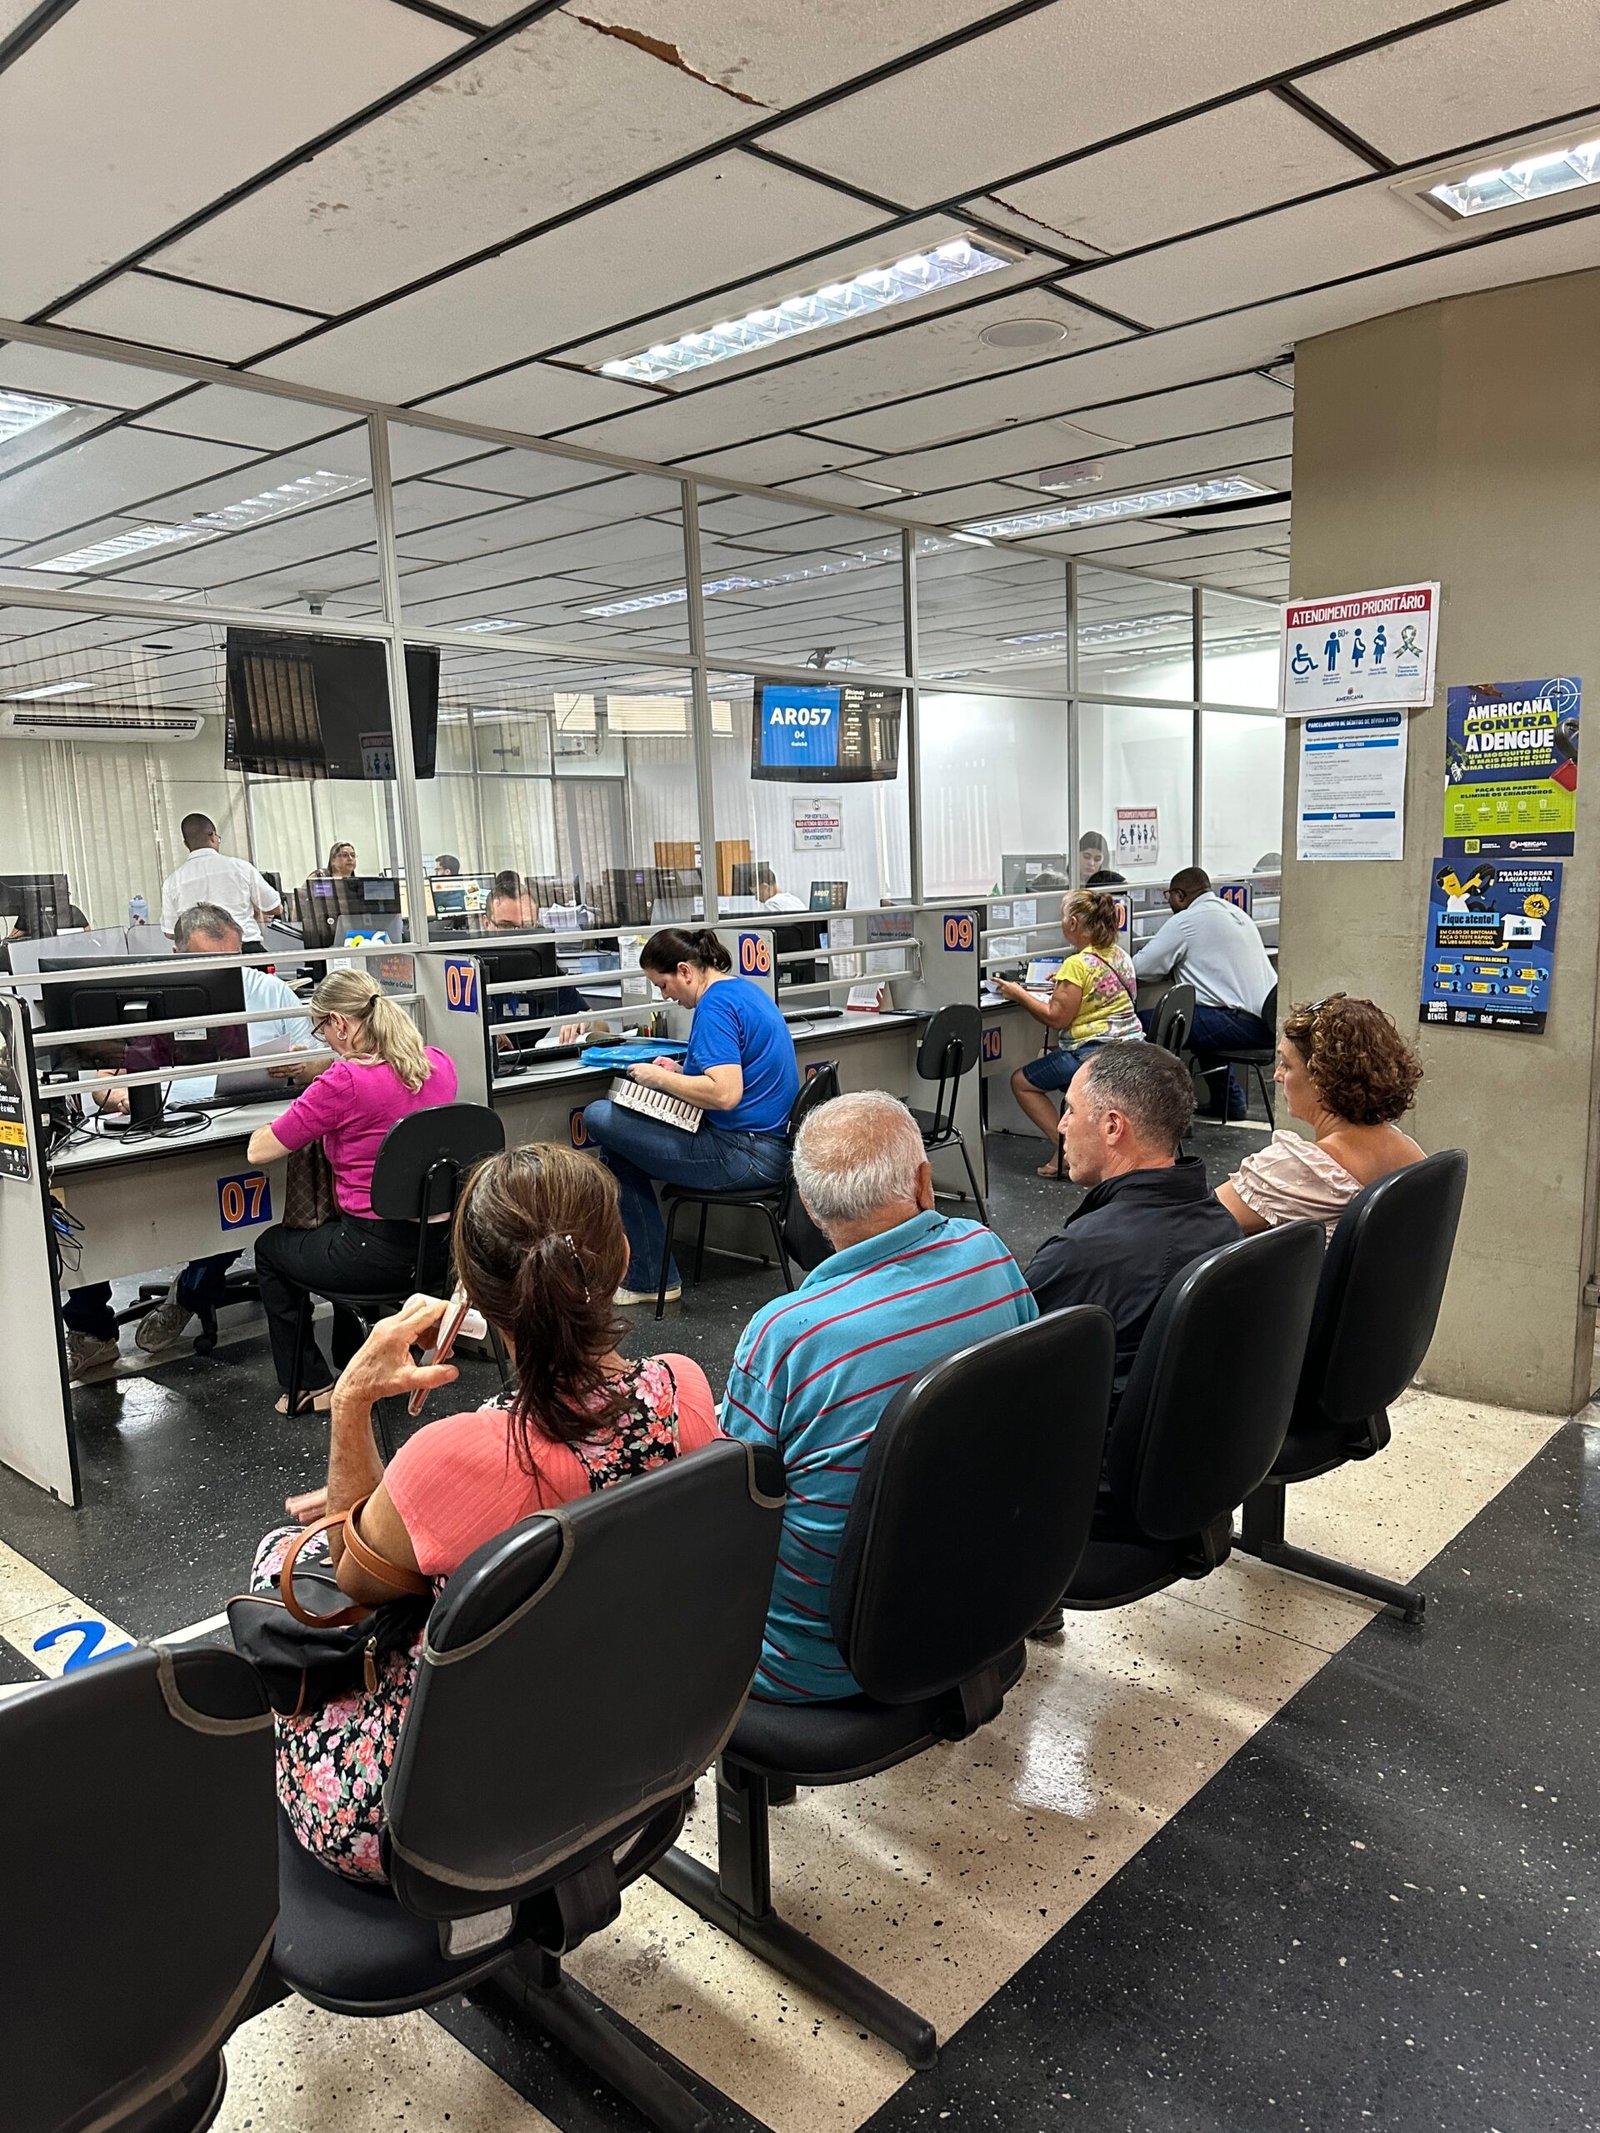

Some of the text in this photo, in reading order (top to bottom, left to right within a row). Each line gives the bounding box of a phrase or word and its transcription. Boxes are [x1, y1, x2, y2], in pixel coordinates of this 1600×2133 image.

[1292, 592, 1426, 626] ATENDIMENTO PRIORITÁRIO
[1336, 694, 1364, 702] AMERICANA
[770, 707, 832, 726] AR057
[1467, 699, 1552, 720] AMERICANA
[1467, 715, 1552, 732] CONTRA
[794, 730, 805, 739] 04
[1466, 729, 1554, 752] A DENGUE
[1484, 750, 1531, 758] MOSQUITO
[1520, 758, 1558, 766] INTEIRA
[1223, 888, 1244, 909] 11
[1442, 914, 1494, 925] Fique atento!
[946, 918, 972, 948] 09
[1516, 927, 1529, 935] UBS
[742, 938, 770, 972] 08
[446, 966, 475, 1006] 07
[984, 1030, 1000, 1058] 10
[222, 1176, 266, 1224] 07
[33, 1620, 136, 1676] 2
